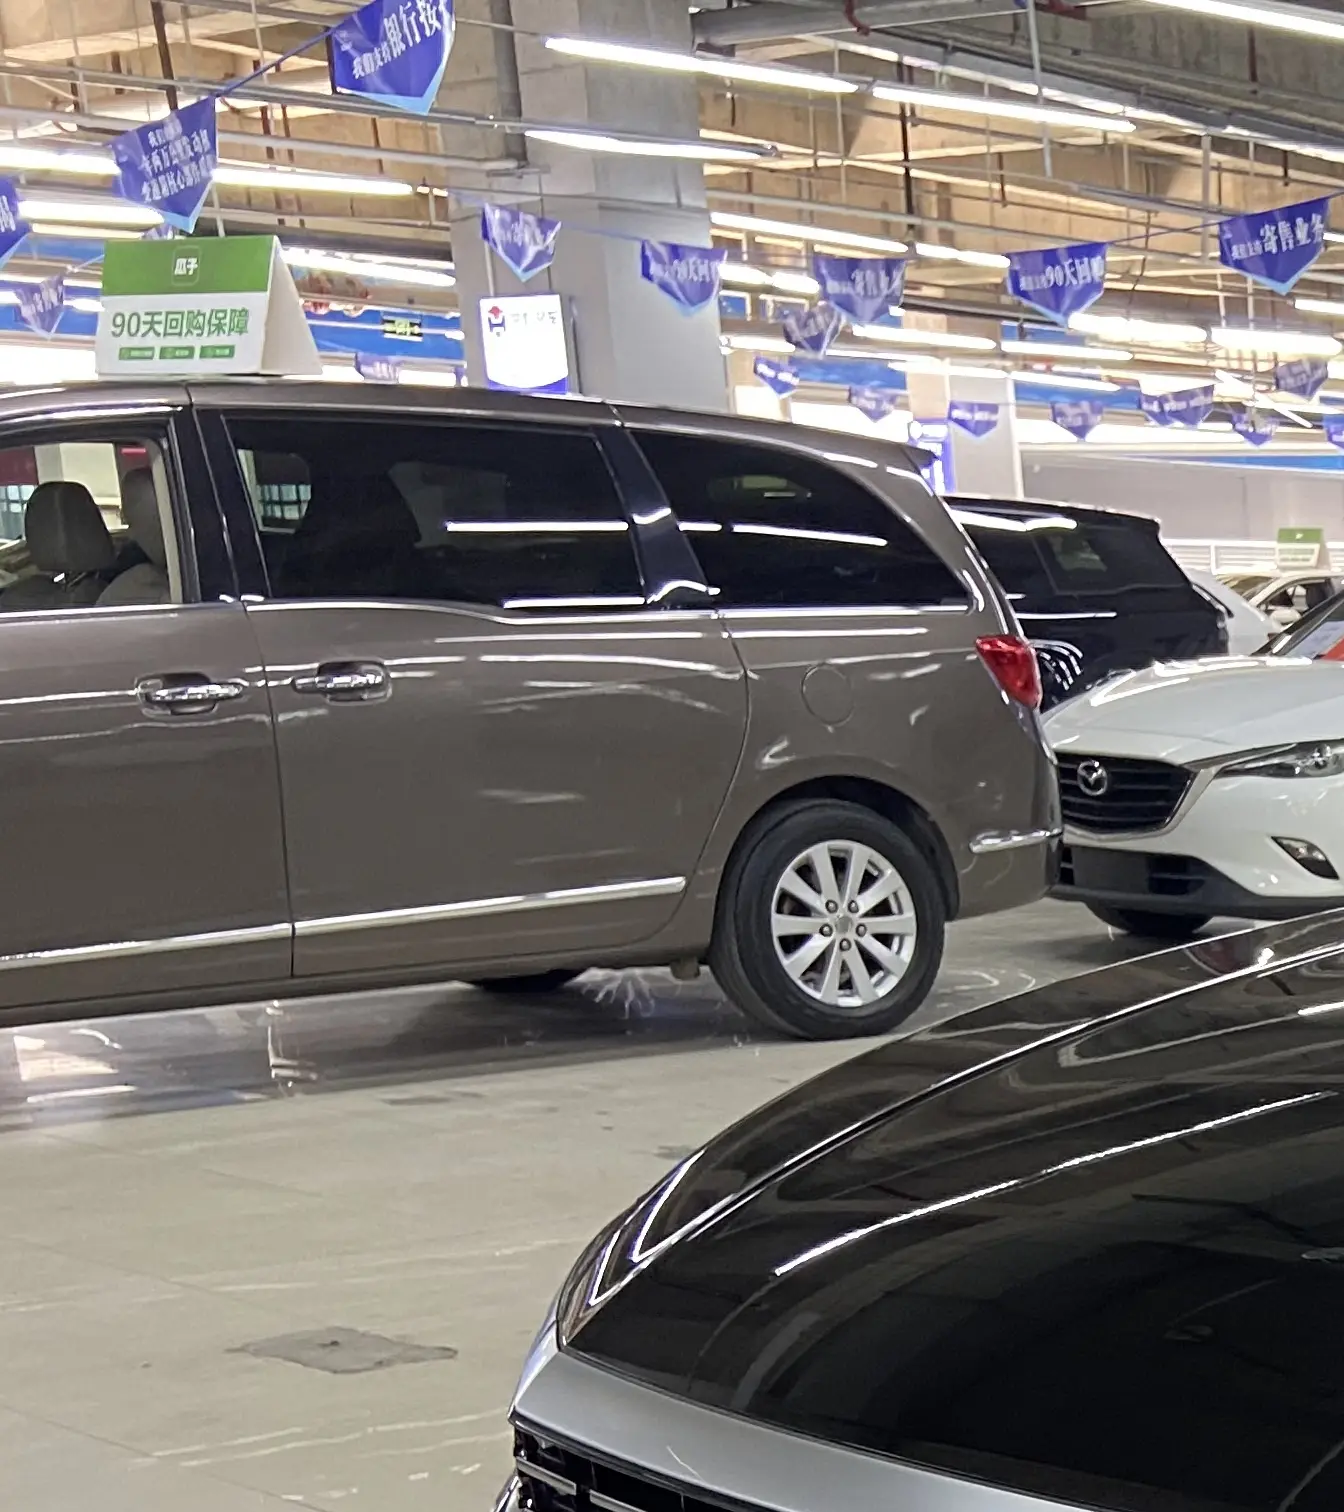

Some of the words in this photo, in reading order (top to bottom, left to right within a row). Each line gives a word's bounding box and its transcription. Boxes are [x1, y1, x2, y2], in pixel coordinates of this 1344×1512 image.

[174, 257, 199, 276] 瓜子
[110, 308, 250, 338] 90天回购保障
